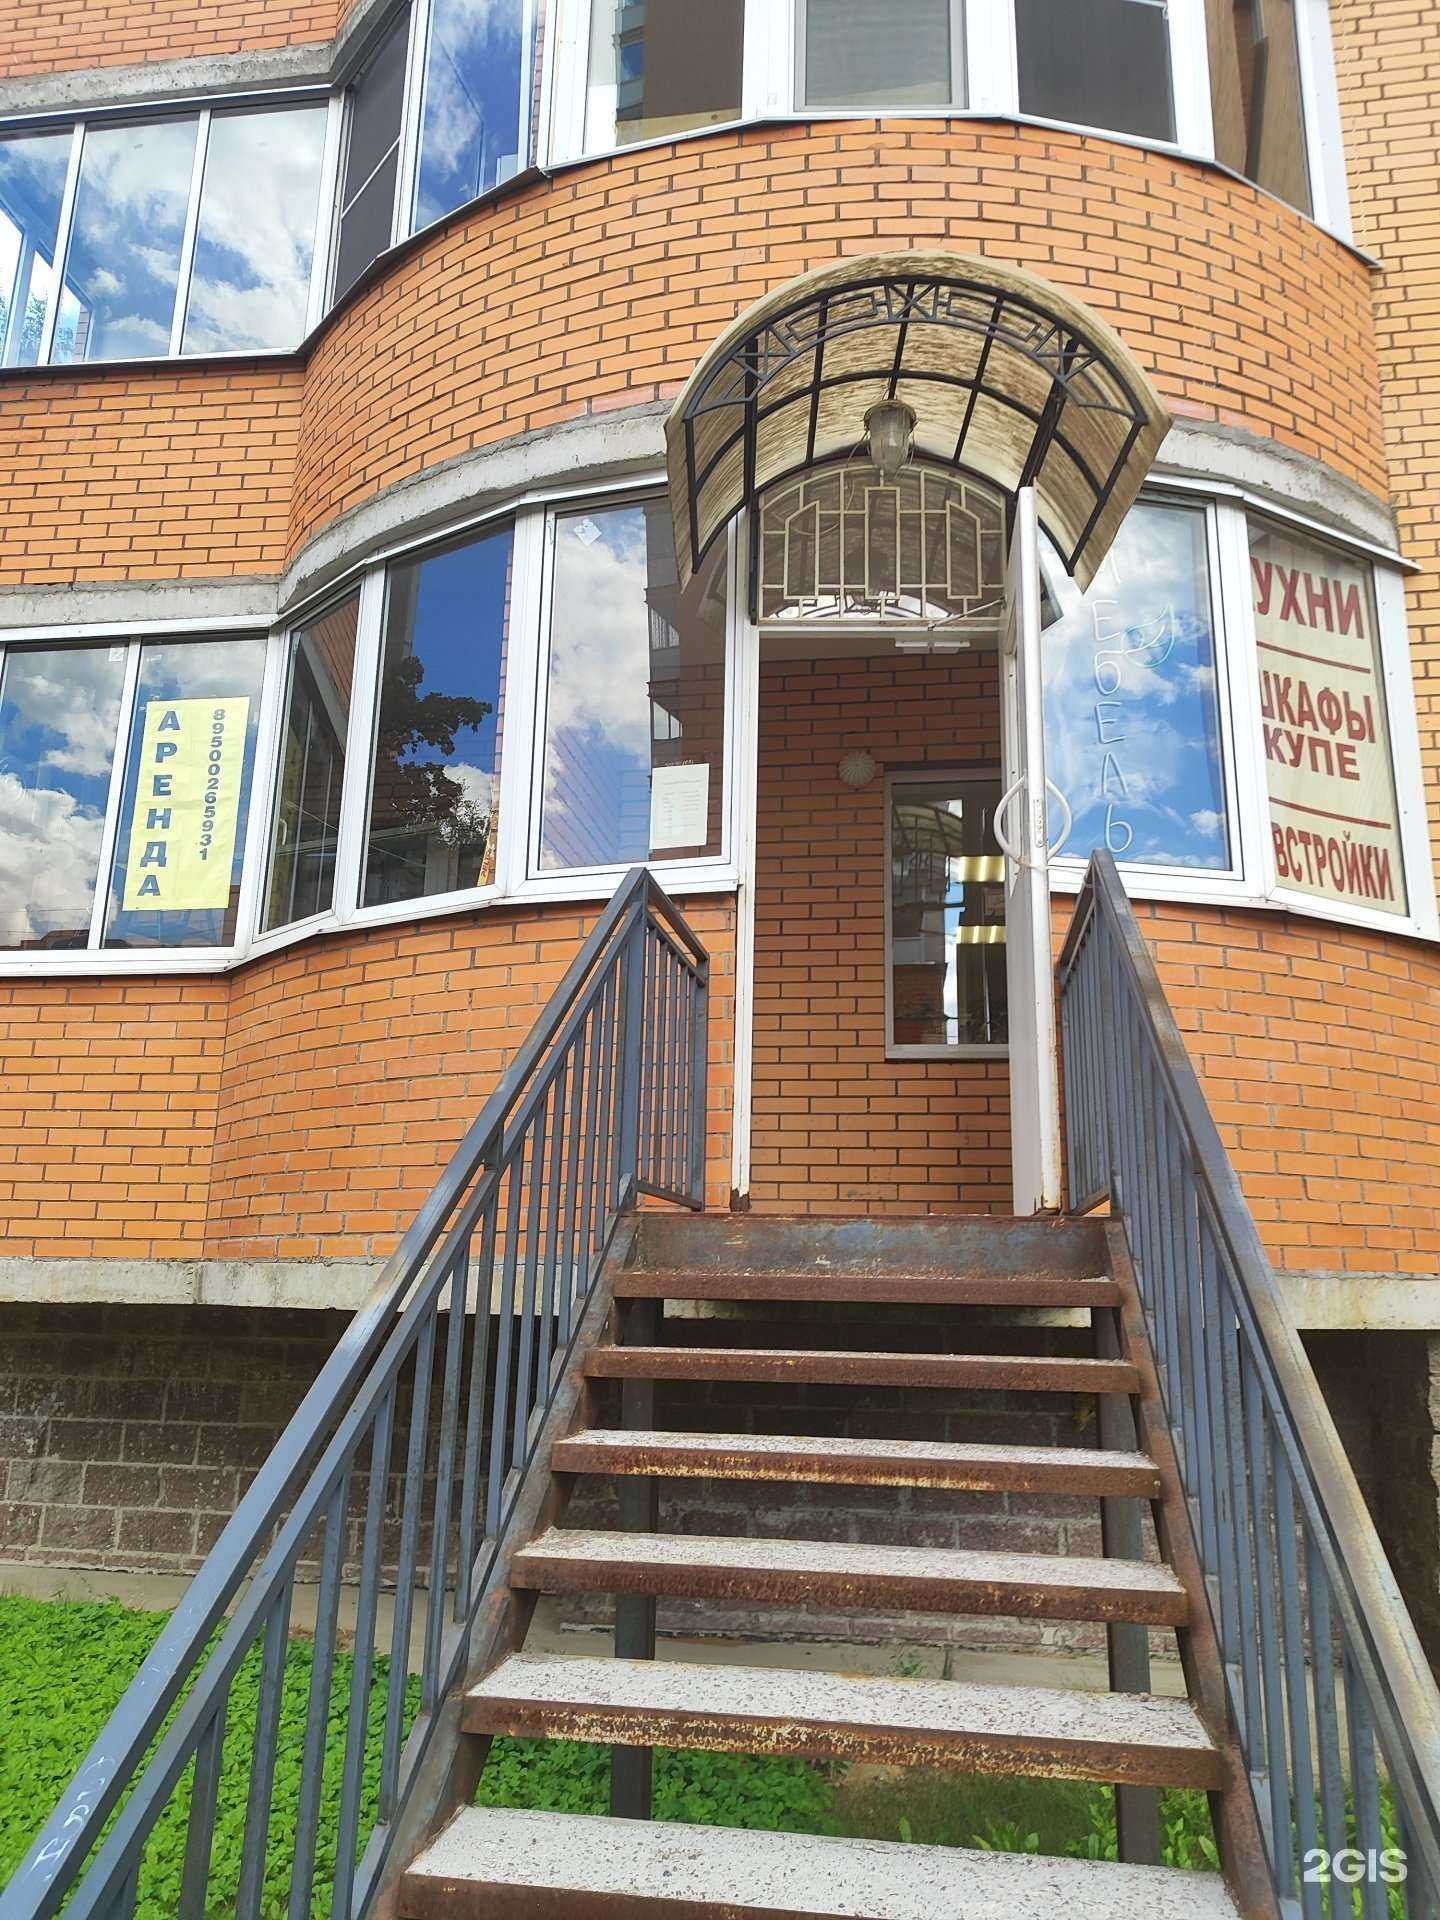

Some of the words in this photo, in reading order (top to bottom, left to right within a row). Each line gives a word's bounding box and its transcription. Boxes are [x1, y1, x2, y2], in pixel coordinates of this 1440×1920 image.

[1250, 556, 1364, 639] УХНИ
[199, 708, 226, 861] 89500265931
[1263, 723, 1360, 781] КУПЕ
[136, 710, 181, 897] АРЕНДА
[1271, 821, 1395, 901] ВСТРОЙКИ
